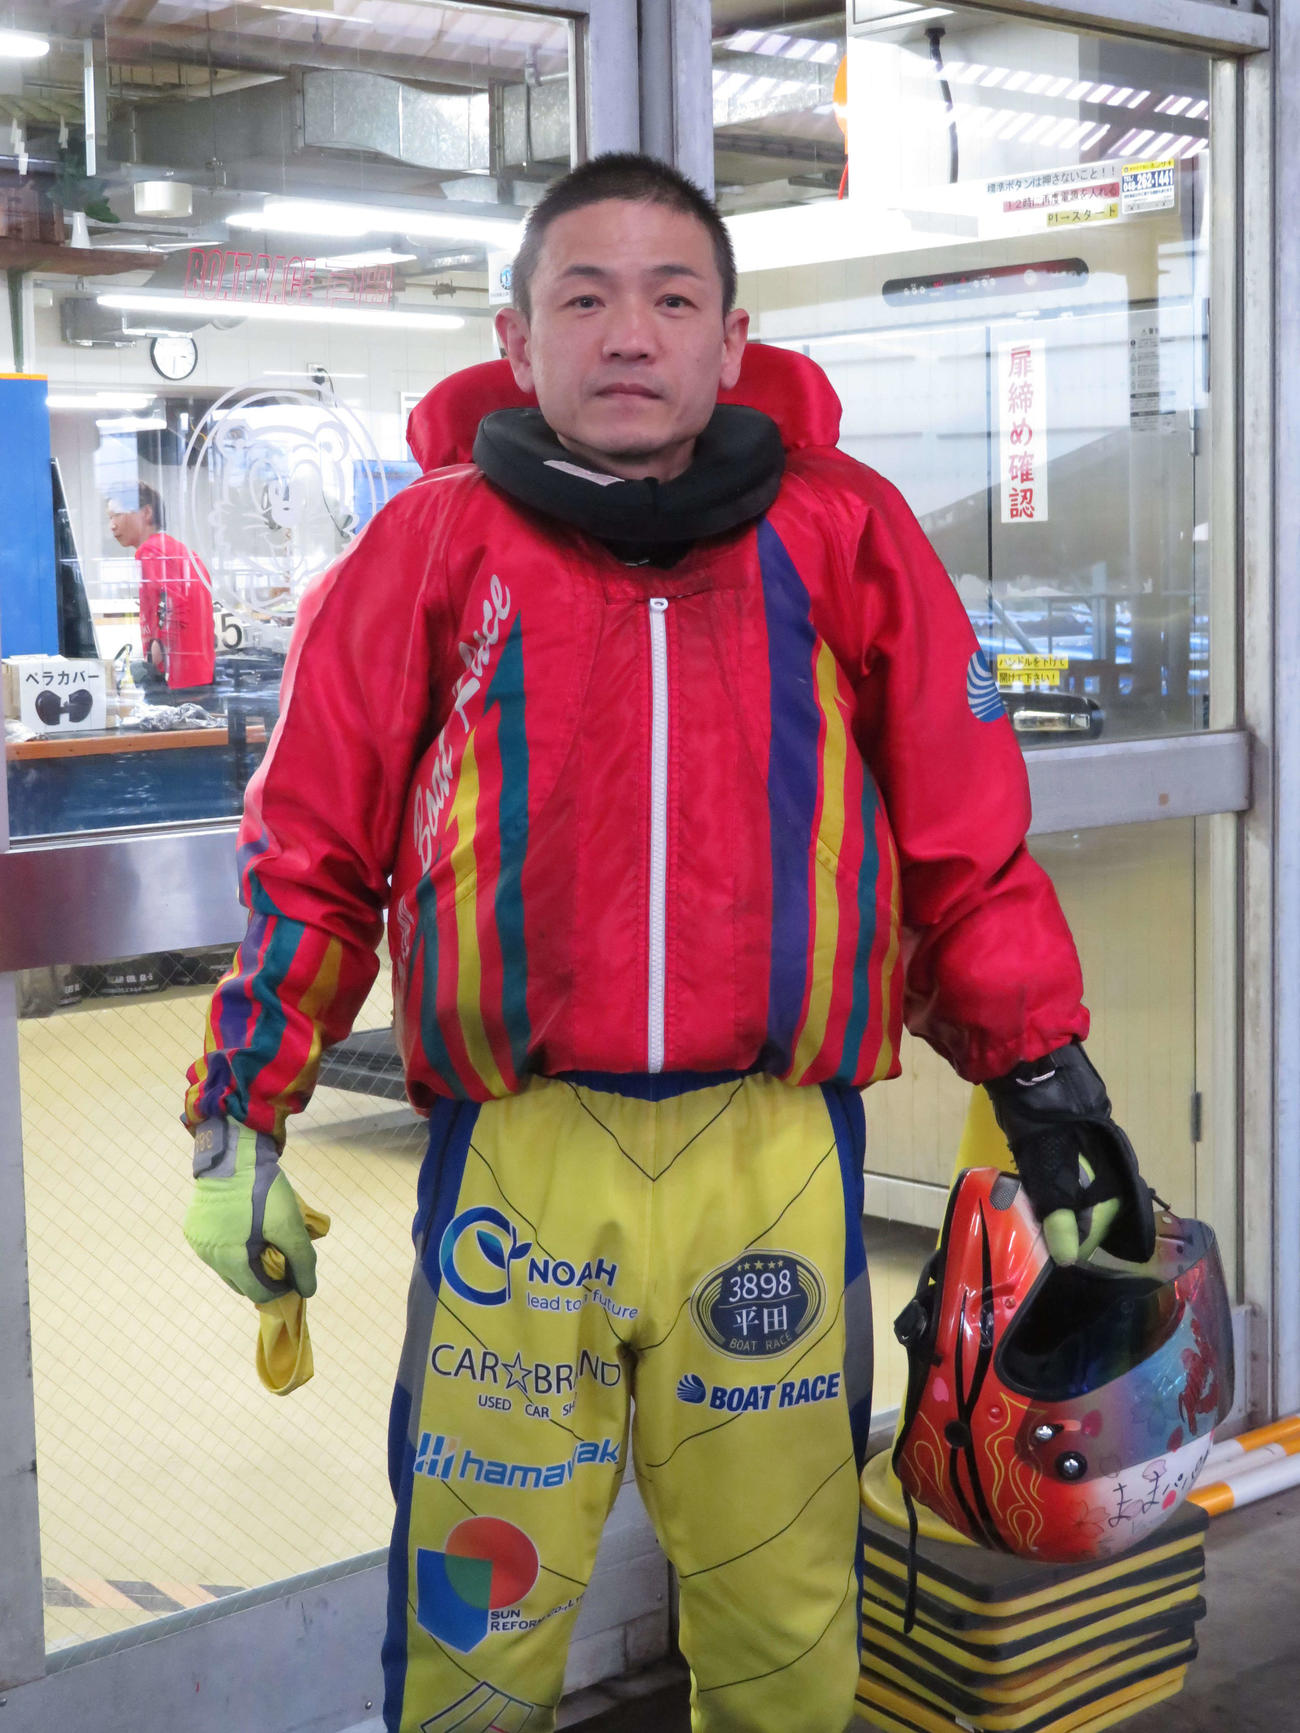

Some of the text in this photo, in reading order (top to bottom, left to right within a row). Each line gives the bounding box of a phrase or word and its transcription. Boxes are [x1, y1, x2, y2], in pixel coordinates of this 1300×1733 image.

[1008, 345, 1035, 519] 扉締め確認
[26, 671, 99, 686] ペラカバー
[414, 727, 453, 876] Boat
[528, 1258, 616, 1287] NOAH
[729, 1269, 791, 1302] 3898
[527, 1292, 560, 1310] lead
[565, 1299, 582, 1312] to
[593, 1288, 638, 1319] future
[732, 1304, 787, 1335] 平田
[729, 1332, 792, 1351] BOAT RACE
[534, 1350, 621, 1394] BRND
[478, 1395, 511, 1411] USED
[525, 1404, 549, 1418] CAR
[709, 1372, 841, 1412] BOAT RACE
[490, 1609, 520, 1619] SUN
